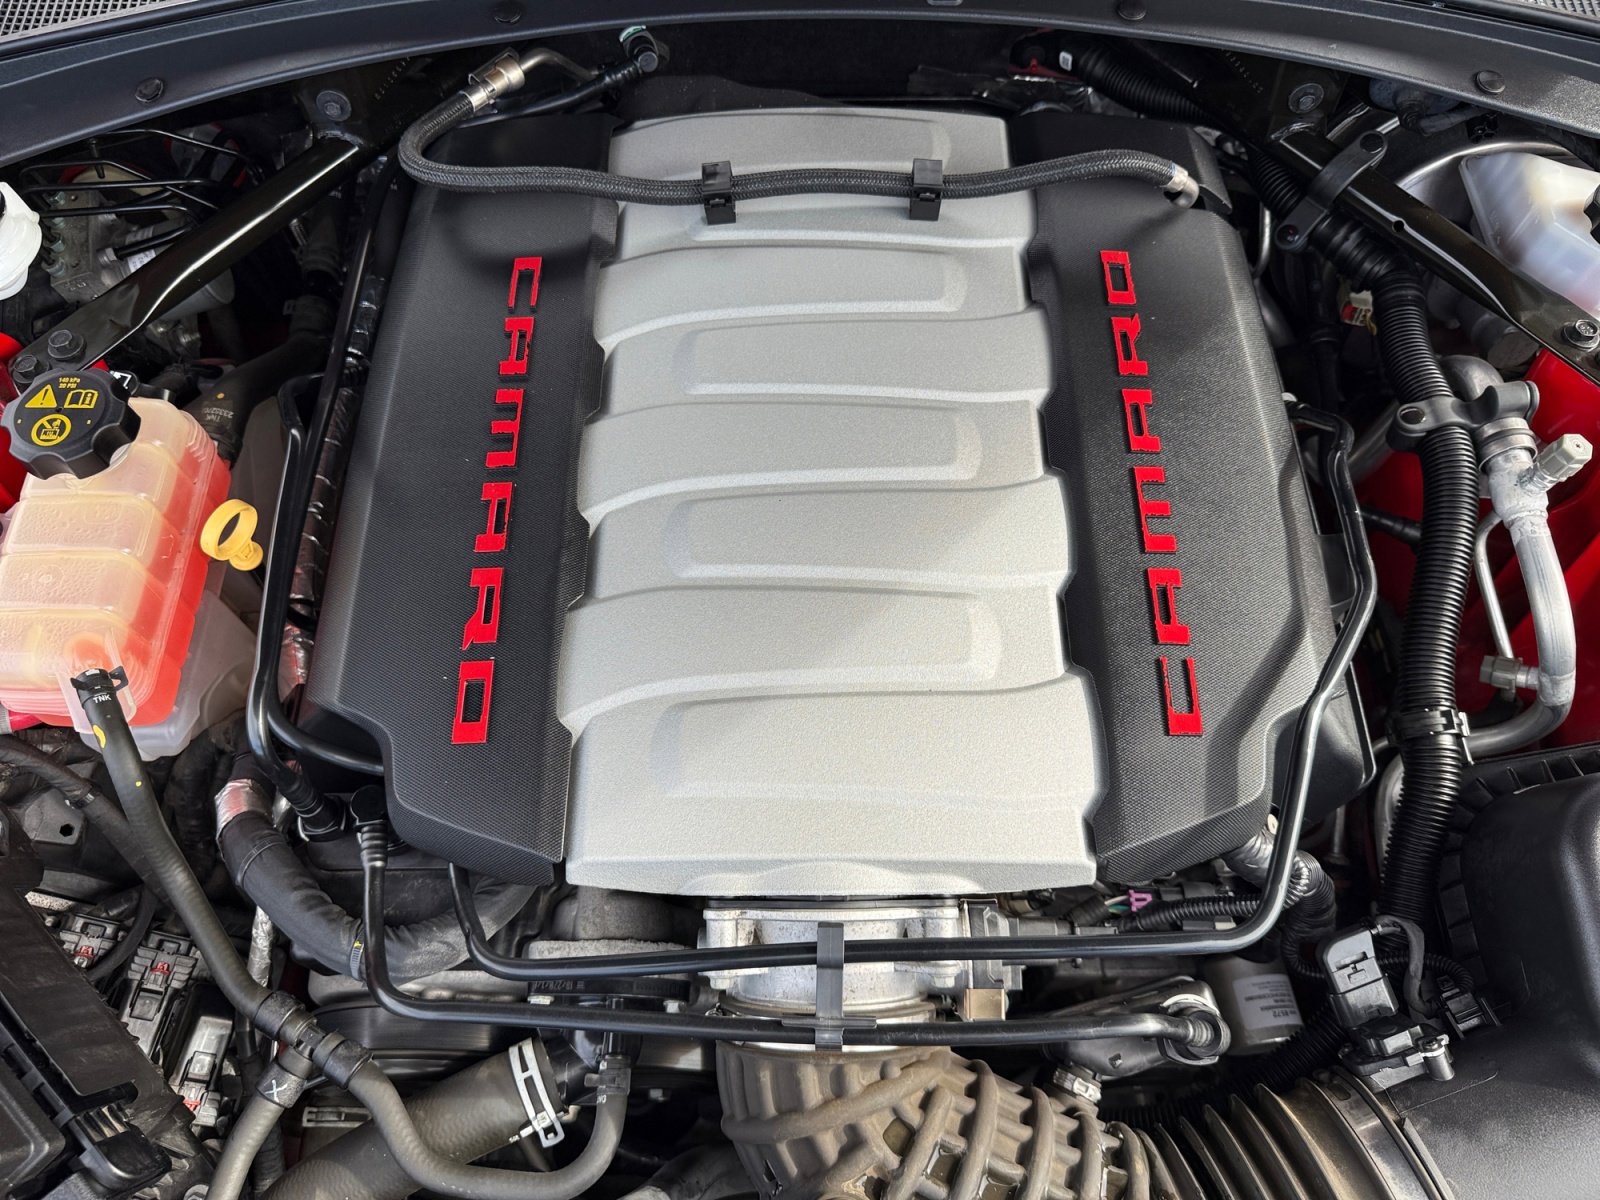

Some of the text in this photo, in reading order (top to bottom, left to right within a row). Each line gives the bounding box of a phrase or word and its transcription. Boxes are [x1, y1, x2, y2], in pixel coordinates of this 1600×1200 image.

[93, 694, 112, 704] TNK
[451, 256, 542, 744] CAMARO
[1100, 250, 1202, 736] CAMARO
